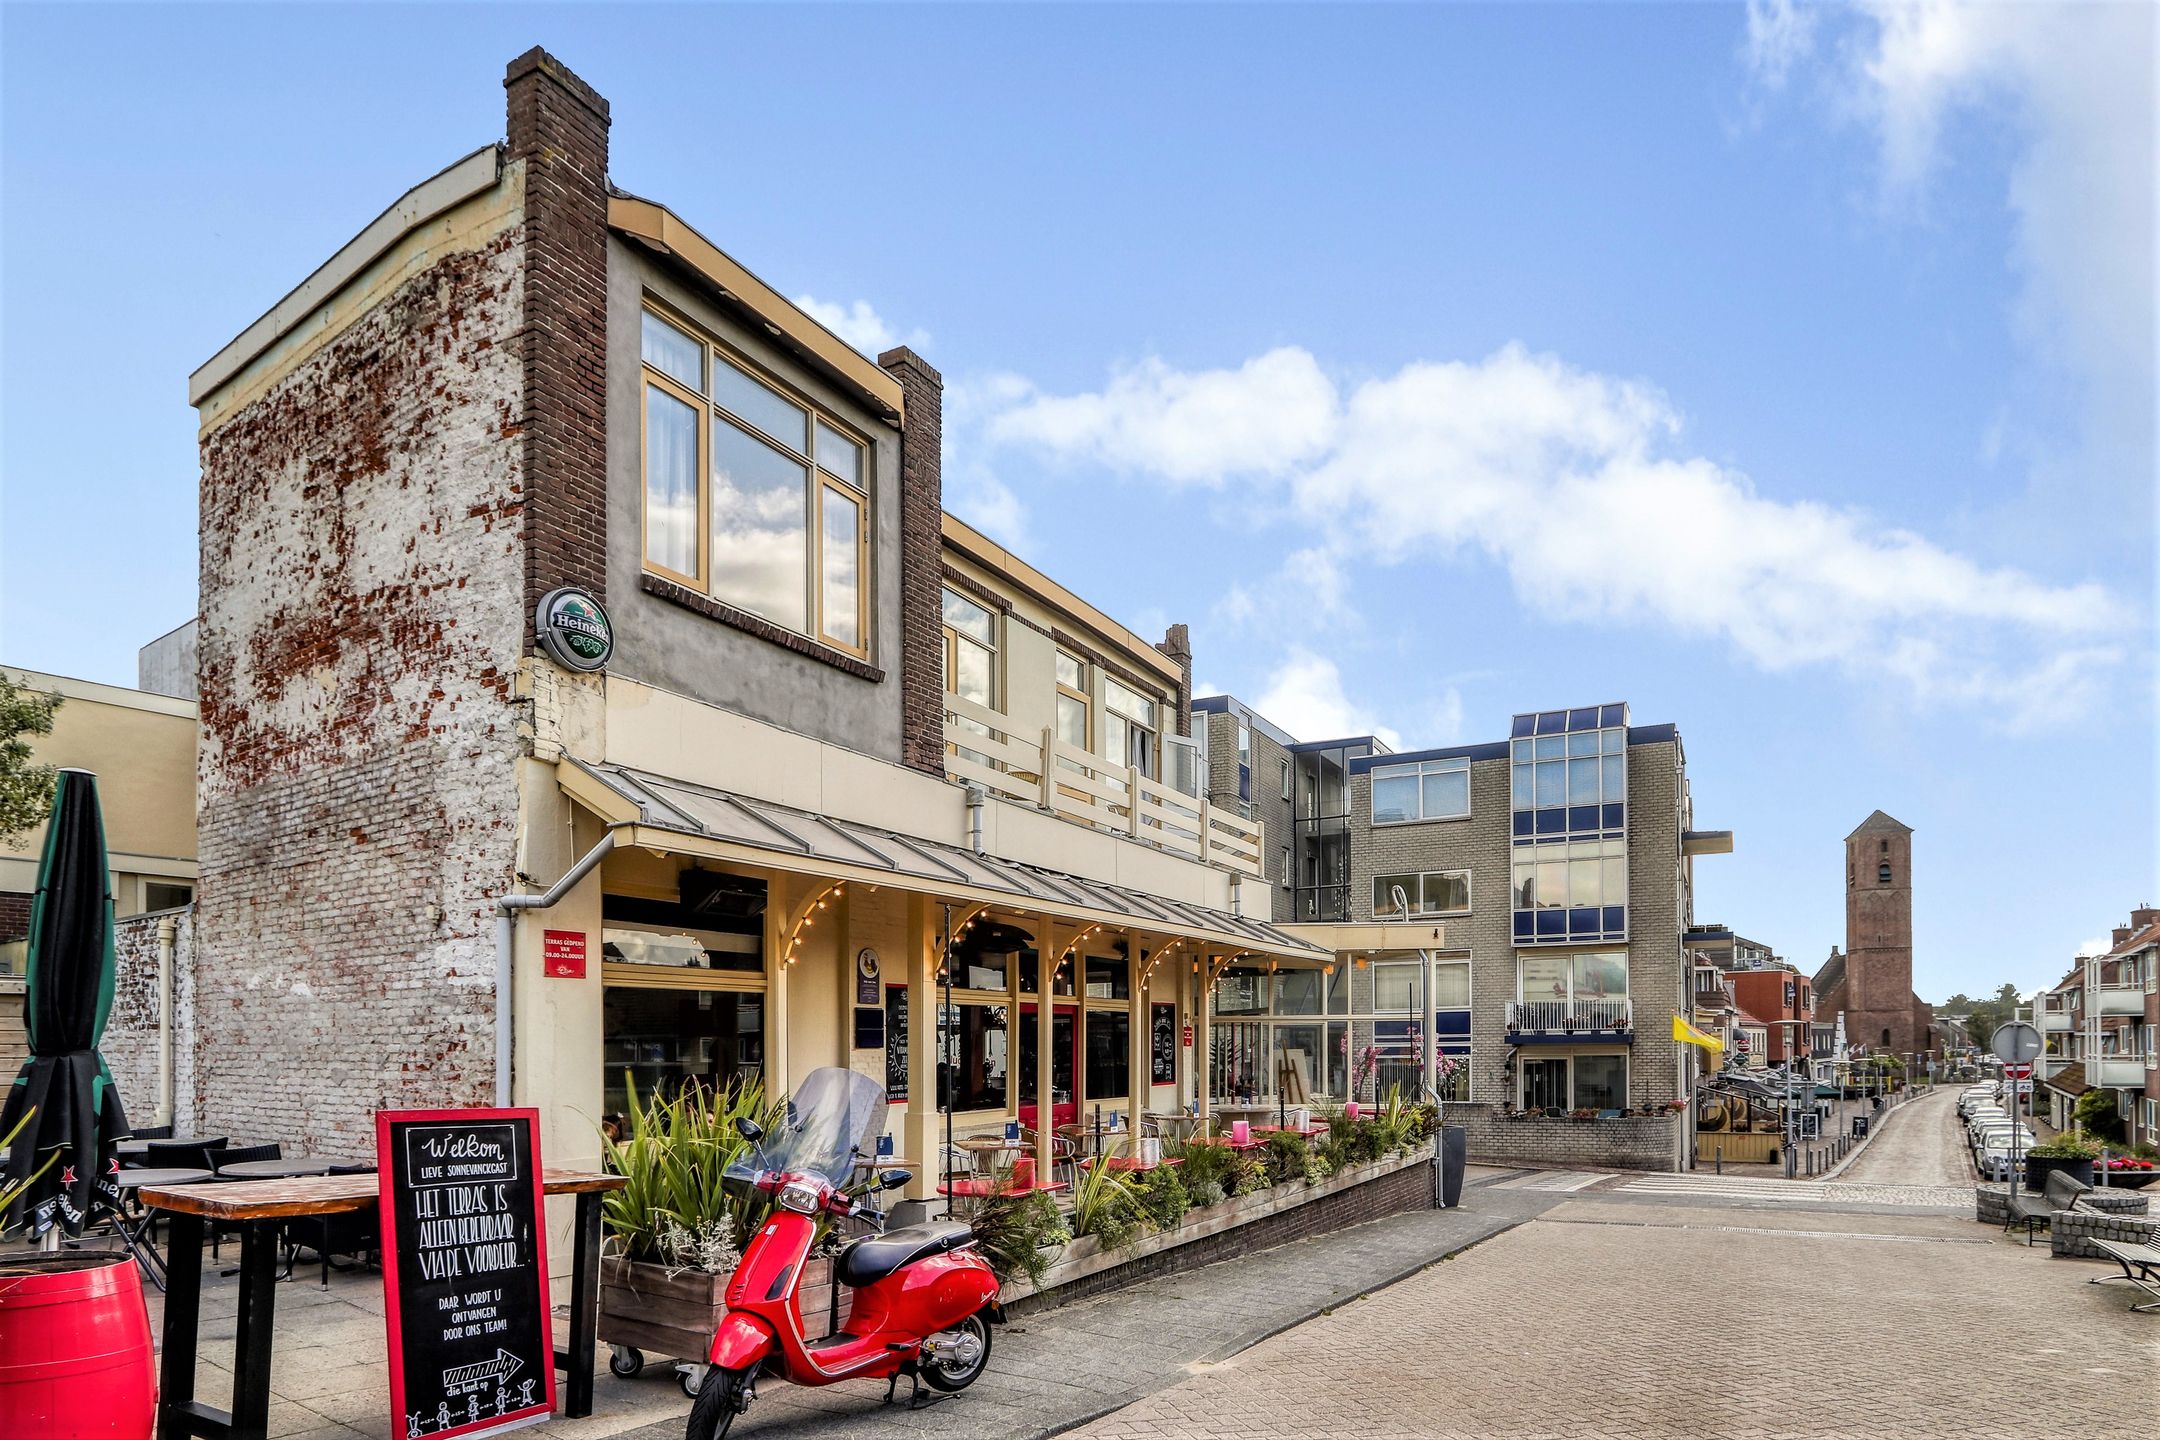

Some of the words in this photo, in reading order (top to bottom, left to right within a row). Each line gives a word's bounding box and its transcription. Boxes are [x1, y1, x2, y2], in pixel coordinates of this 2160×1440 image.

[421, 1133, 505, 1161] Welkom
[421, 1166, 443, 1179] LIEVE
[447, 1162, 508, 1177] SONNEVANCKGAST
[415, 1189, 440, 1219] HET
[445, 1185, 488, 1216] TERRAS
[494, 1184, 508, 1211] IS
[419, 1218, 457, 1249] ALLEEN
[458, 1213, 514, 1245] BEREIKBAAR
[418, 1250, 446, 1280] VIA
[446, 1247, 462, 1277] DE
[438, 1295, 459, 1310] DAAR
[464, 1290, 492, 1305] WORDT
[494, 1288, 502, 1301] U
[451, 1306, 497, 1324] ONTVANGEN
[443, 1327, 463, 1341] DOOR
[465, 1323, 481, 1337] ONS
[484, 1318, 507, 1333] TEAM!
[446, 1386, 461, 1397] die
[462, 1380, 479, 1393] kant
[479, 1381, 489, 1391] op
